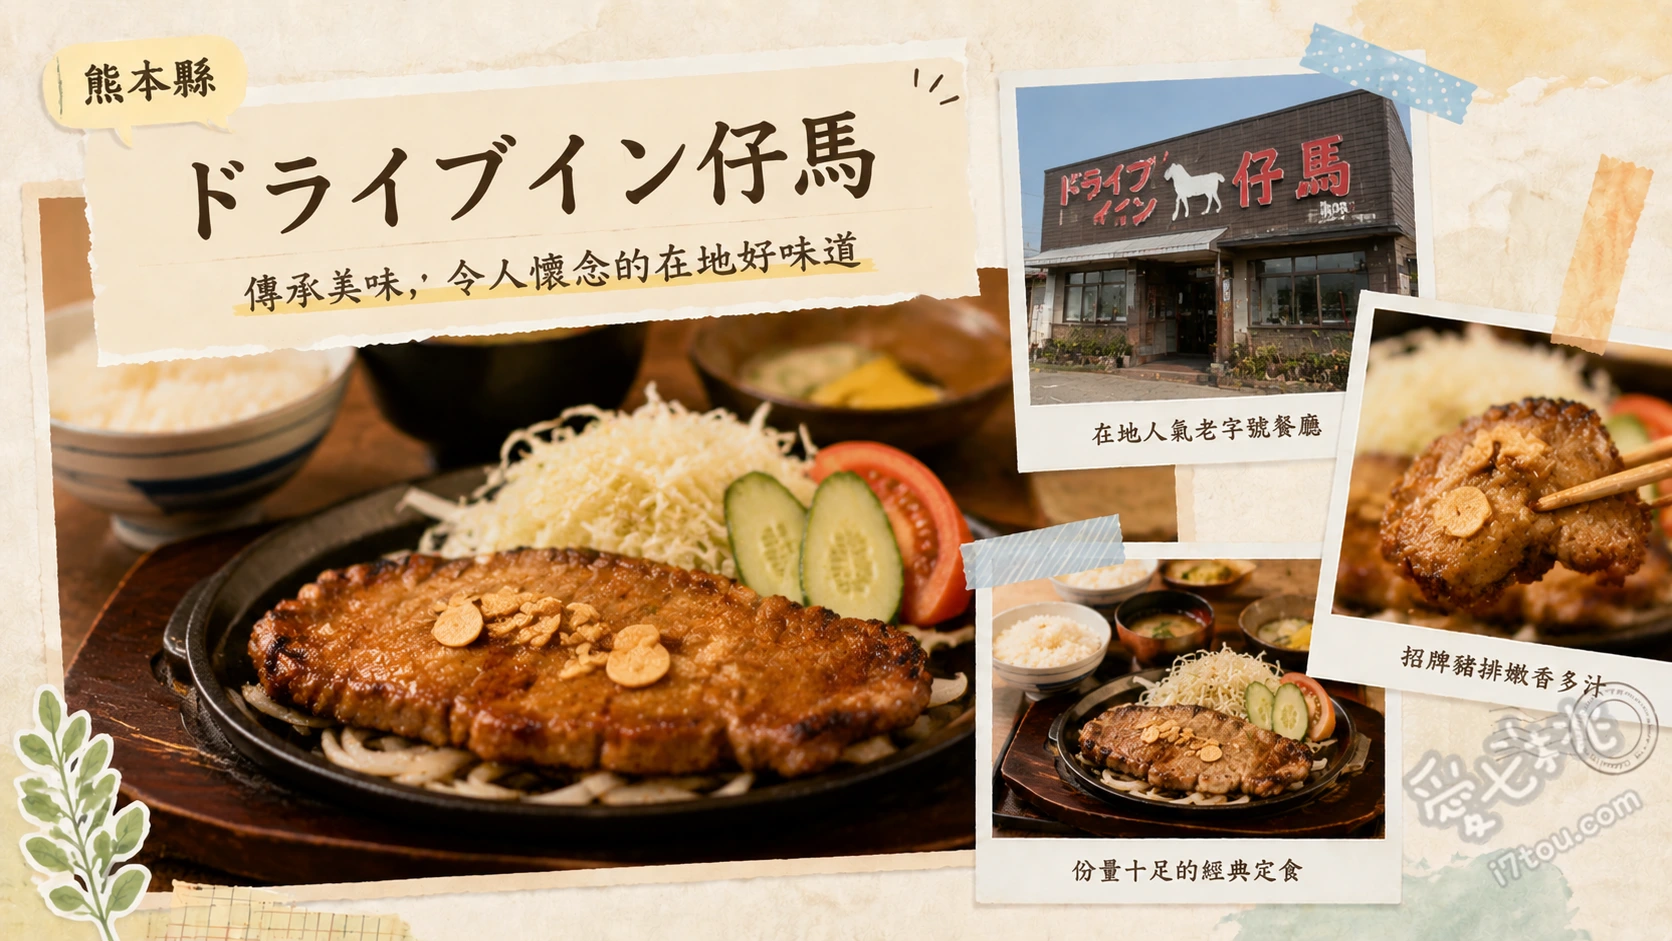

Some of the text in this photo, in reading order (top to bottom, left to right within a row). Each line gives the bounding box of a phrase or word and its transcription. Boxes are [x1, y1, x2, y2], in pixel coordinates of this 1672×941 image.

[84, 57, 217, 106] 熊本縣
[190, 110, 876, 241] ドライブイン仔馬
[1232, 134, 1351, 208] 仔馬
[1092, 413, 1322, 446] 在地人氣老字號餐廳
[1400, 645, 1607, 698] 招牌豬排嫩香多汁
[1071, 858, 1303, 883] 份量十足的經典定食
